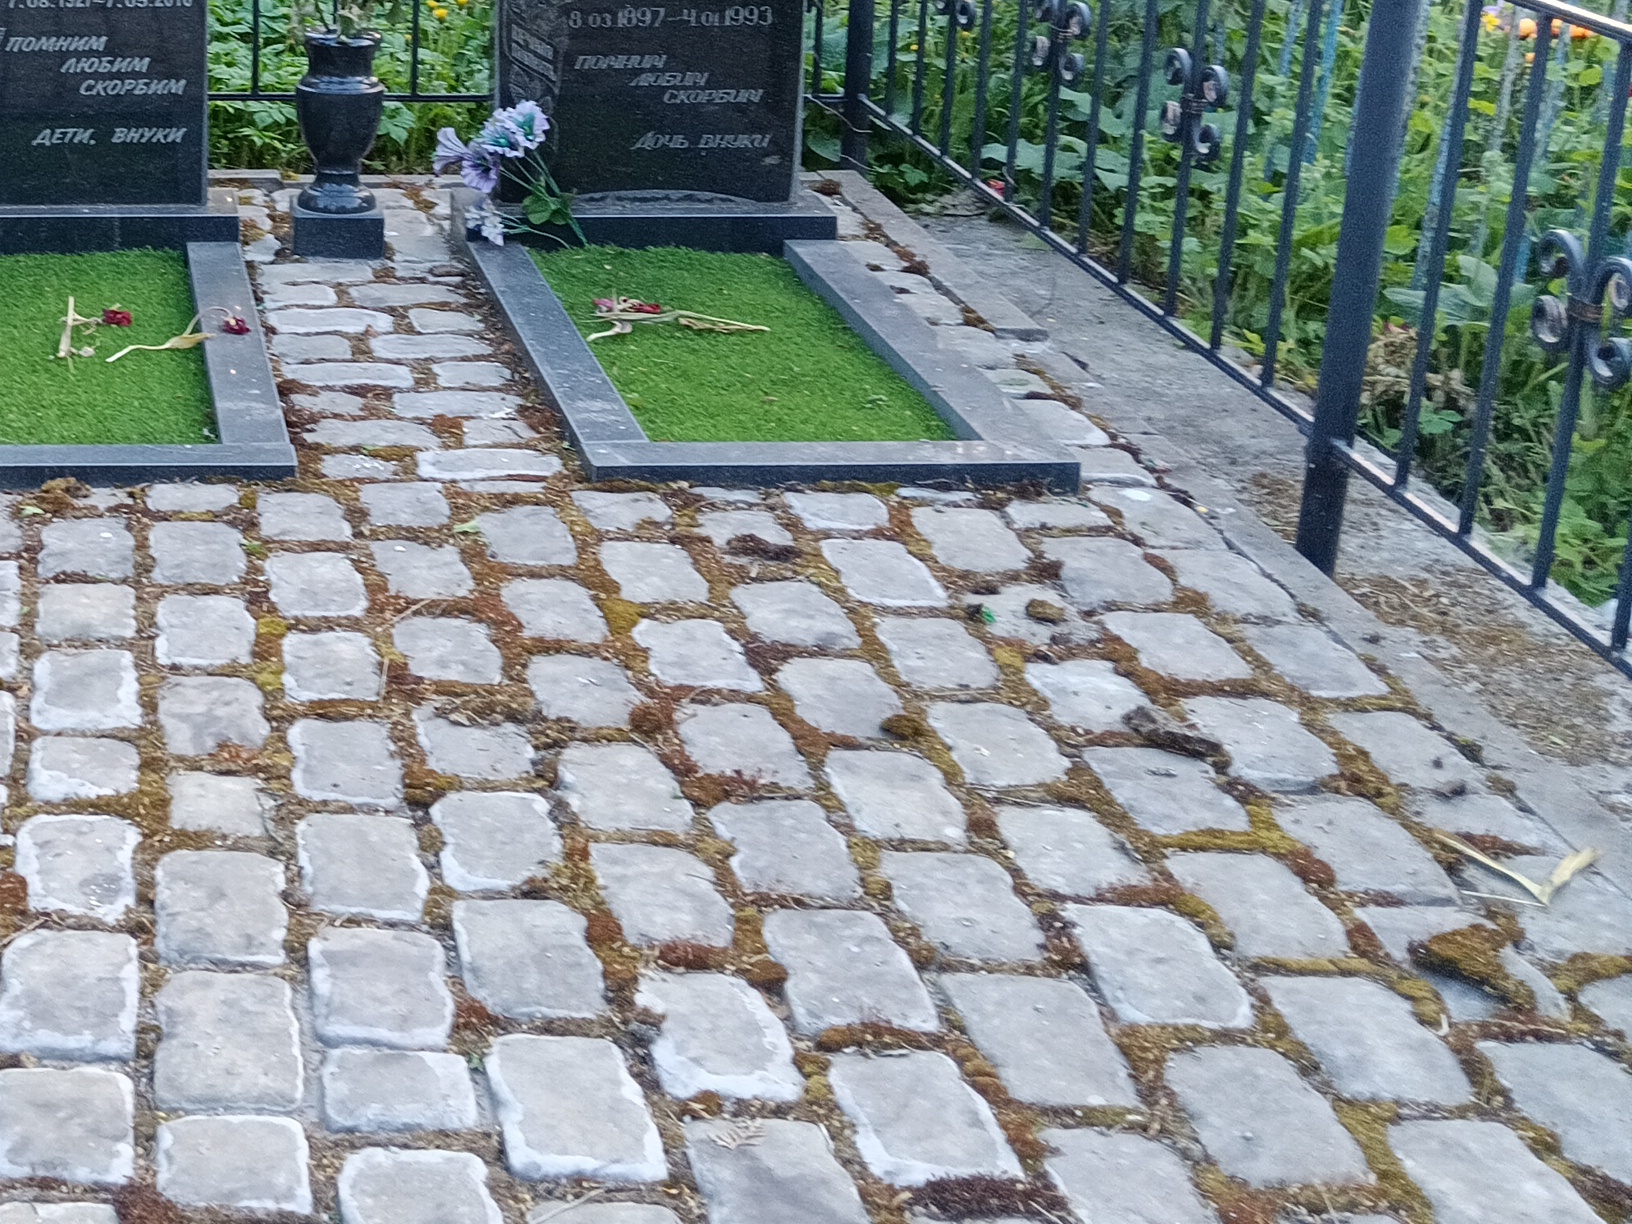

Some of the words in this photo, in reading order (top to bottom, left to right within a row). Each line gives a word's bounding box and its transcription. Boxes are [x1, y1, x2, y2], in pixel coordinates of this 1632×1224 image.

[5, 36, 108, 52] ПОМНИМ
[60, 56, 151, 73] ЛЮБИМ
[574, 54, 667, 69] ПОМНИМ
[79, 78, 187, 96] СКОРБИМ
[663, 89, 764, 104] СКОРБИМ
[111, 127, 187, 144] ВНУКИ
